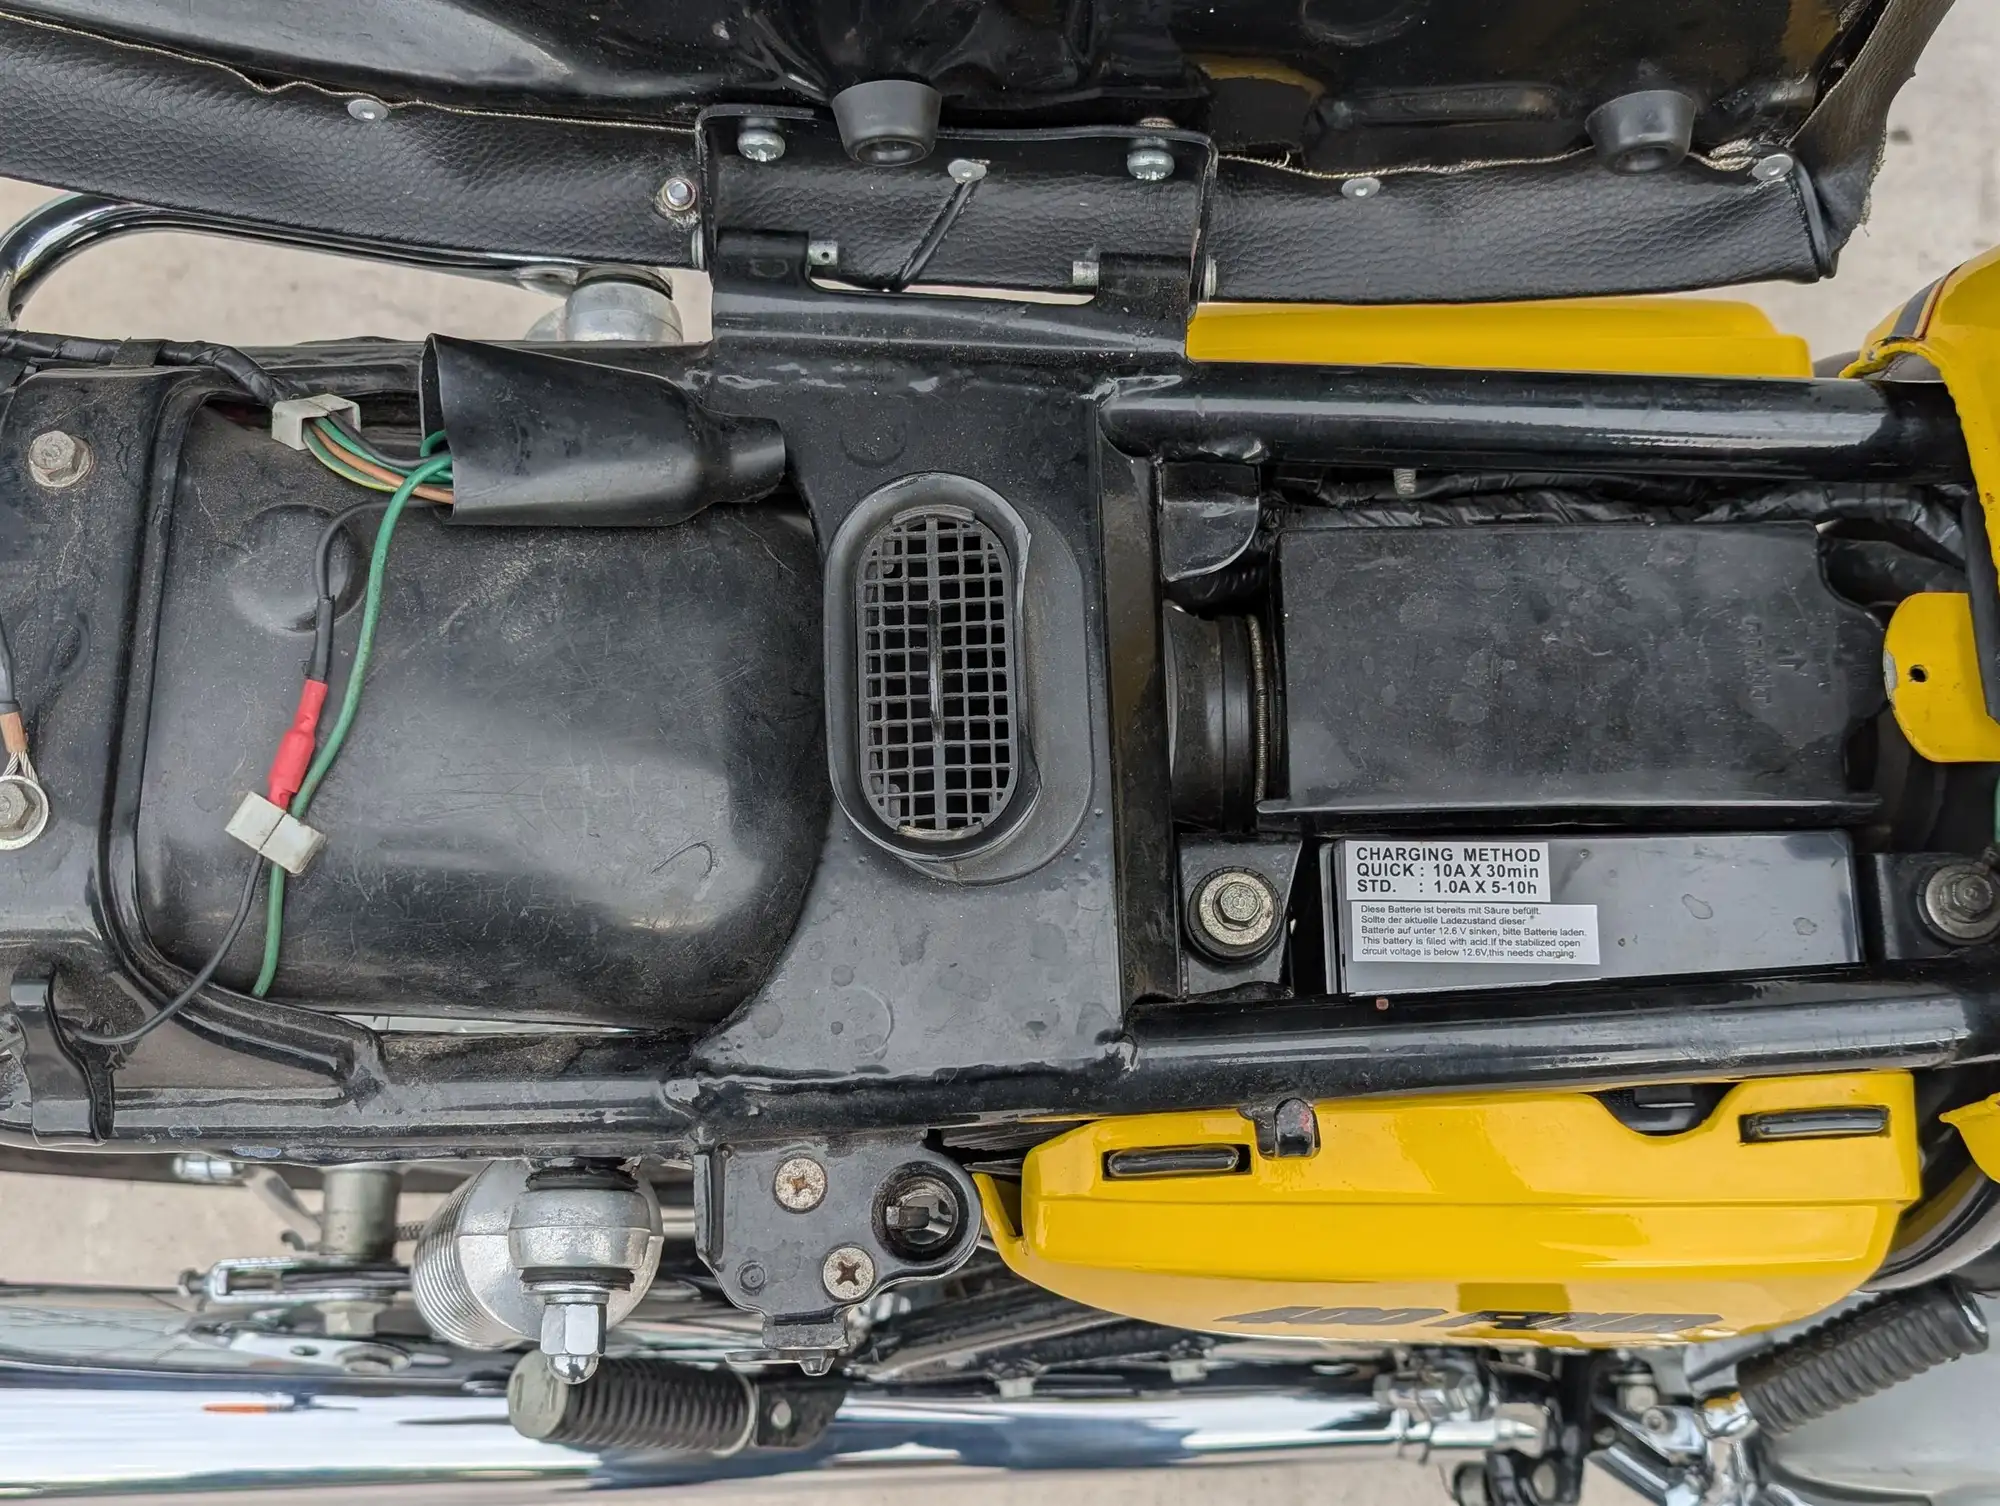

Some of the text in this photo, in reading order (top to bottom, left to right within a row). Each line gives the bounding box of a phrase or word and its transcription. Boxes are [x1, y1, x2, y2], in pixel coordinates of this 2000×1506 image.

[1356, 847, 1541, 862] CHARGING METHOD
[1433, 863, 1466, 877] 10A
[1470, 864, 1482, 877] X
[1486, 864, 1539, 878] 30min
[1357, 879, 1396, 893] STD.
[1434, 880, 1471, 893] 1.0A
[1475, 880, 1487, 893] X
[1492, 881, 1537, 894] 5-10h
[1361, 905, 1386, 913] Diese
[1388, 905, 1421, 914] Batterie
[1424, 905, 1434, 914] ist
[1436, 905, 1466, 914] bereits
[1468, 906, 1481, 914] mit
[1484, 906, 1510, 915] Säure
[1361, 915, 1526, 925] Sollte der aktuelle Ladezustand dieser
[1361, 926, 1587, 936] Batterie auf unter 12.6 V sinken, bitte Batterie laden.
[1362, 937, 1380, 945] This
[1383, 937, 1413, 946] battery
[1416, 937, 1423, 945] is
[1426, 937, 1446, 945] filled
[1499, 938, 1512, 946] the
[1558, 940, 1581, 948] open
[1362, 947, 1387, 955] circuit
[1390, 948, 1421, 957] voltage
[1434, 948, 1459, 956] below
[1507, 949, 1534, 957] needs
[1536, 949, 1577, 958] charging.
